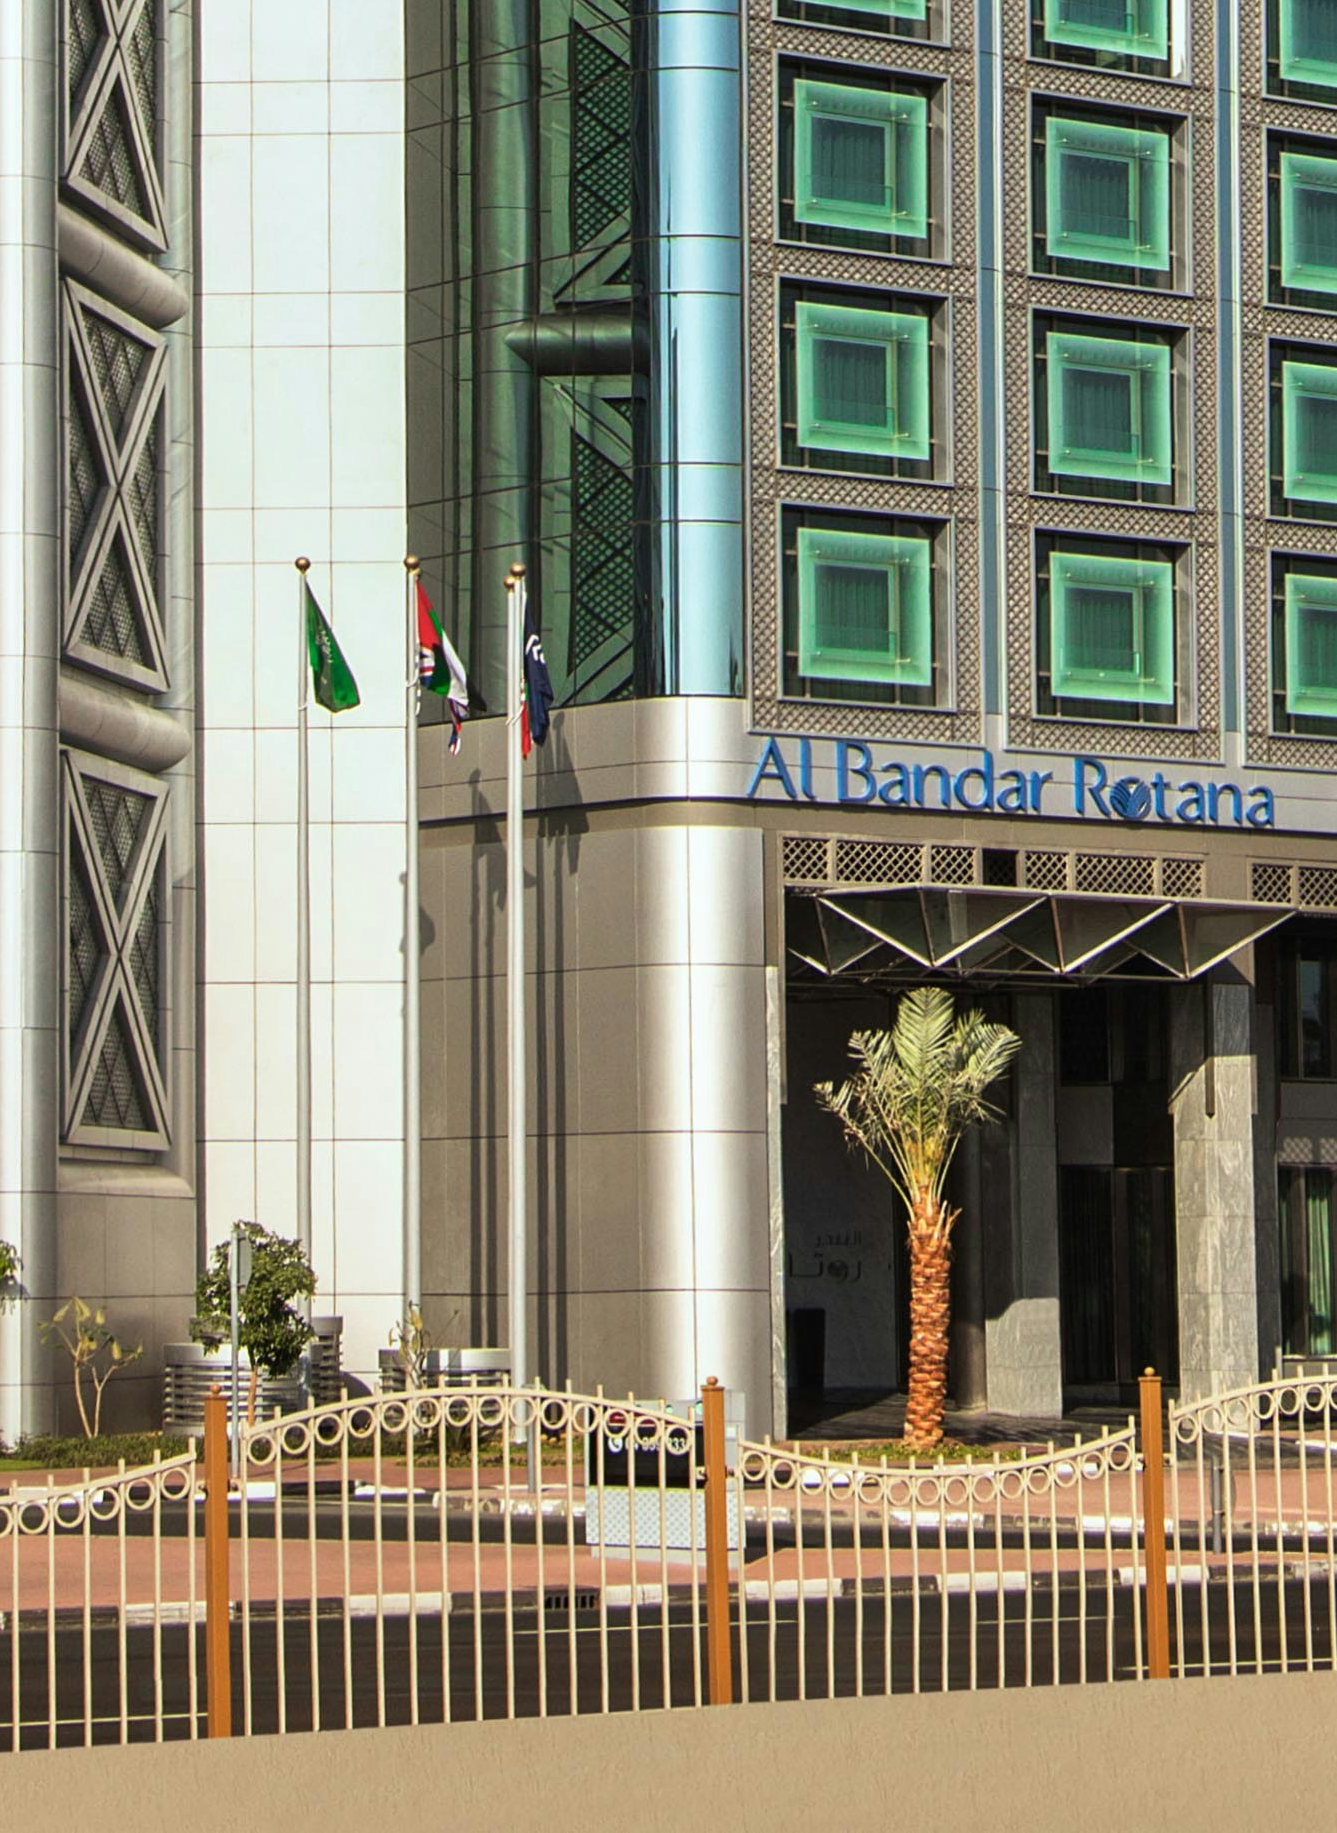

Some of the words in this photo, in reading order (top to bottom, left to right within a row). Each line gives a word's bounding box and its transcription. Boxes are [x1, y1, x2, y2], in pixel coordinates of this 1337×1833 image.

[746, 736, 817, 801] Al
[835, 739, 1054, 812] Bandar
[1073, 756, 1276, 827] Rotana
